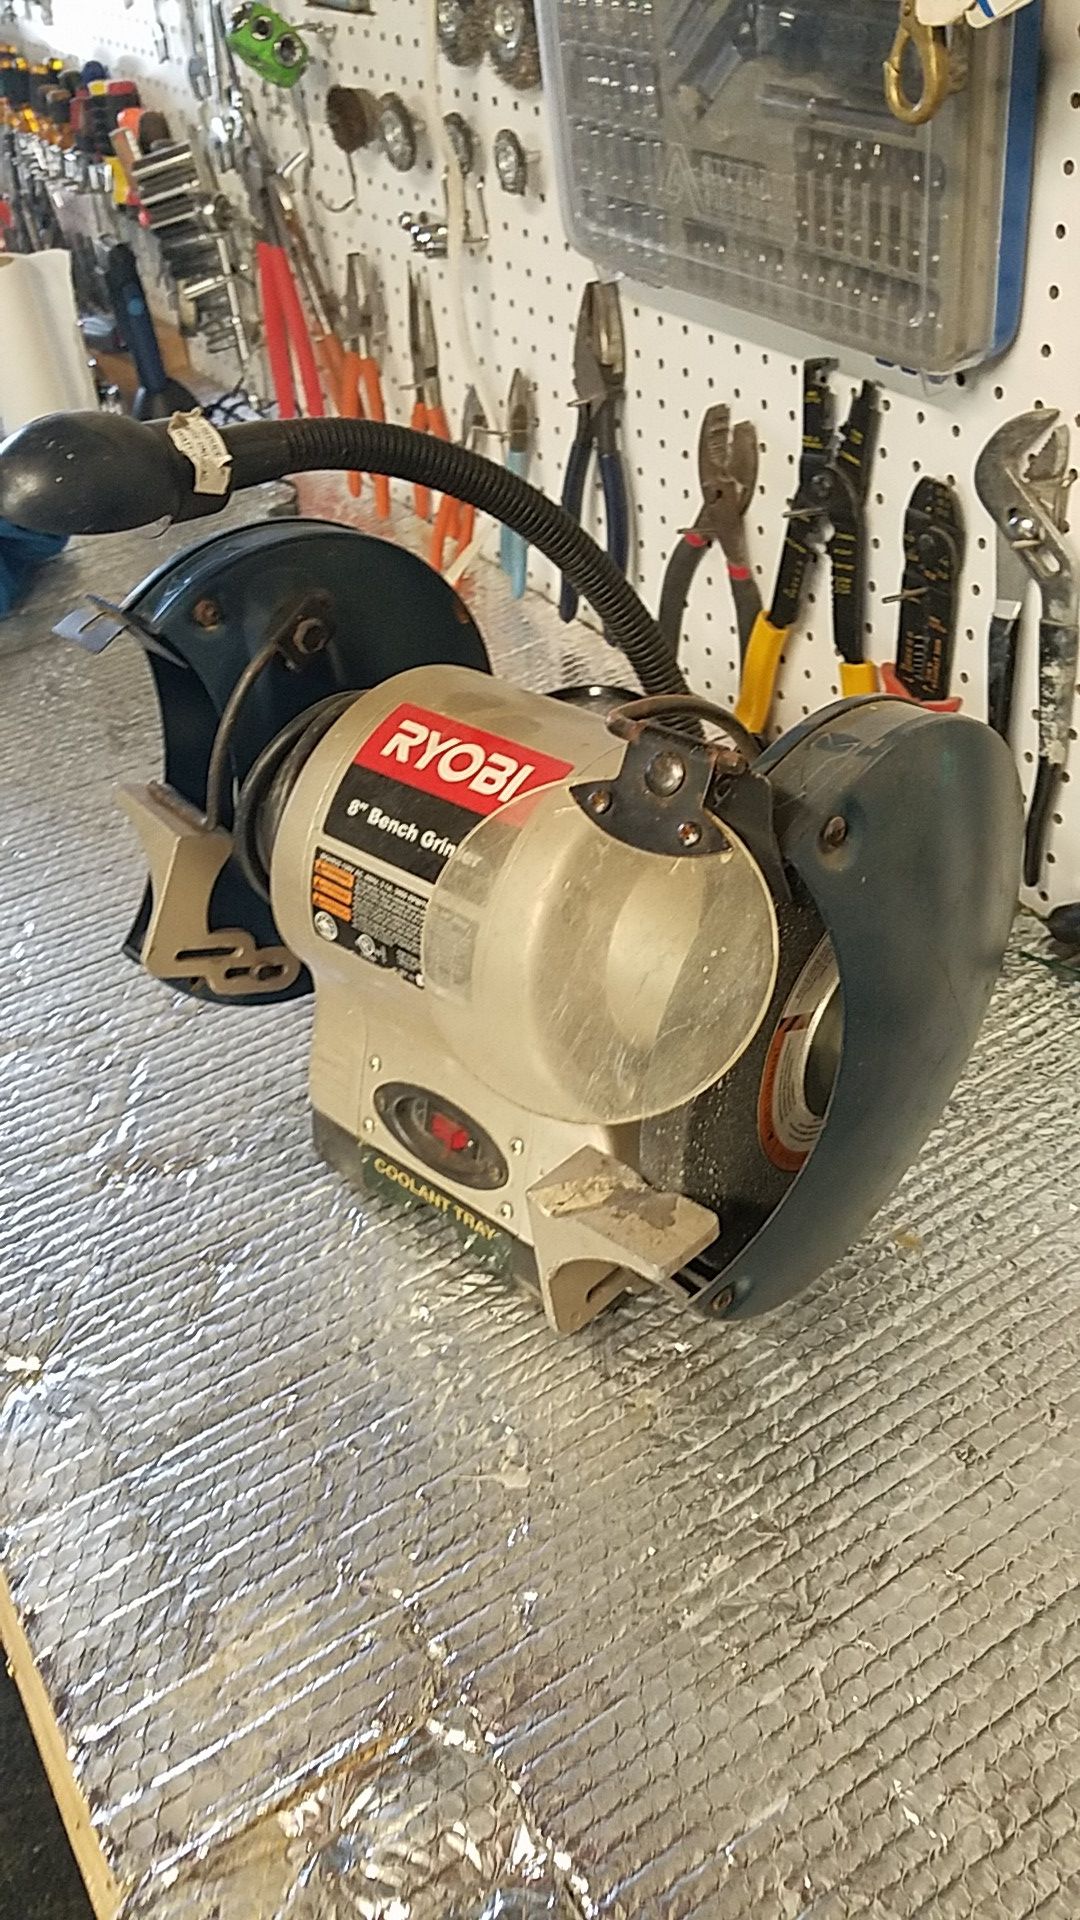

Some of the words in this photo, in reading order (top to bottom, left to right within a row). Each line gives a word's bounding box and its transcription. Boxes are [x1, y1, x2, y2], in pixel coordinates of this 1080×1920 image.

[379, 719, 536, 803] RYOBI
[346, 798, 370, 817] 8"
[366, 806, 419, 843] Bench
[374, 1157, 452, 1213] COOLANT
[453, 1204, 496, 1241] TRAY
